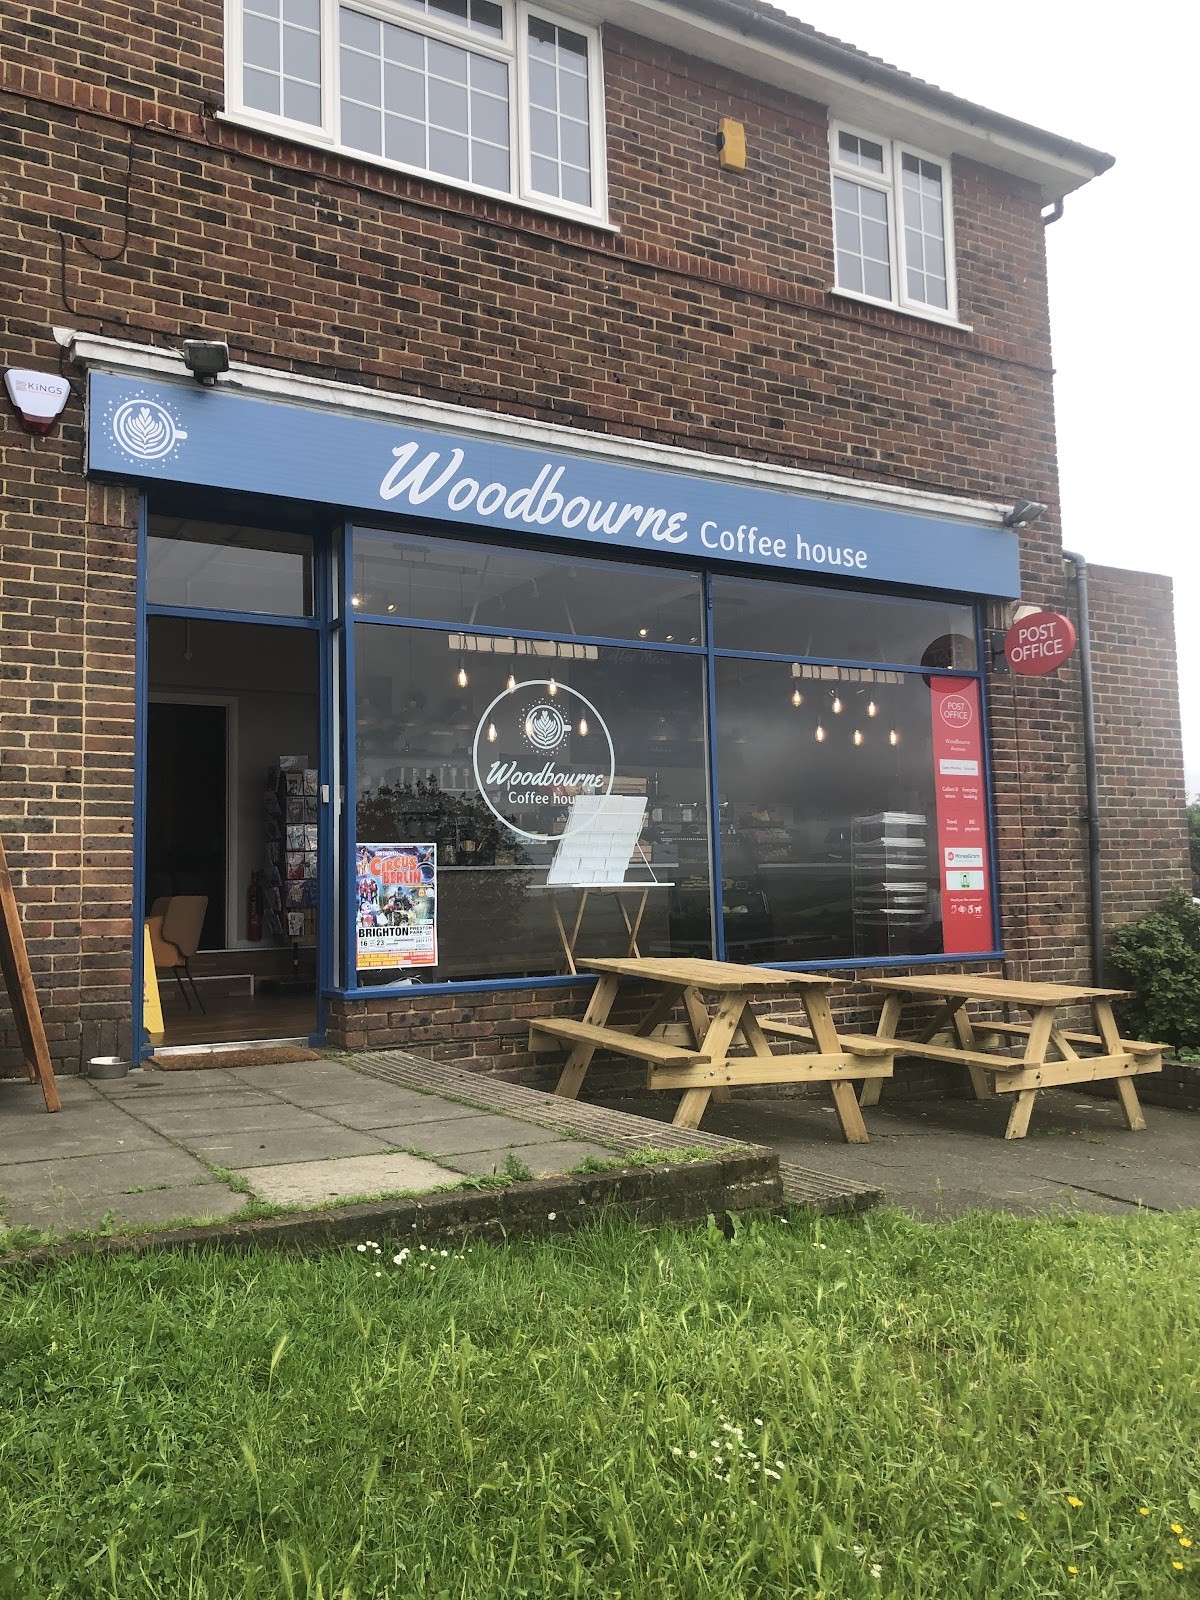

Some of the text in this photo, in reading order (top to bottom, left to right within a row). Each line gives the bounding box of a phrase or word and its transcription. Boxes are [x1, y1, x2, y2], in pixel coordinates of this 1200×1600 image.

[379, 441, 868, 569] Woodbourne Coffee house
[1019, 621, 1057, 644] POST
[1010, 639, 1064, 663] OFFICE
[943, 710, 969, 720] OFFICE
[947, 702, 965, 711] POST
[486, 760, 604, 788] Woodbourne
[508, 791, 549, 804] Coffee
[370, 856, 418, 876] CIRCUS
[383, 870, 421, 884] BERLIN
[358, 927, 409, 938] BRIGHTON
